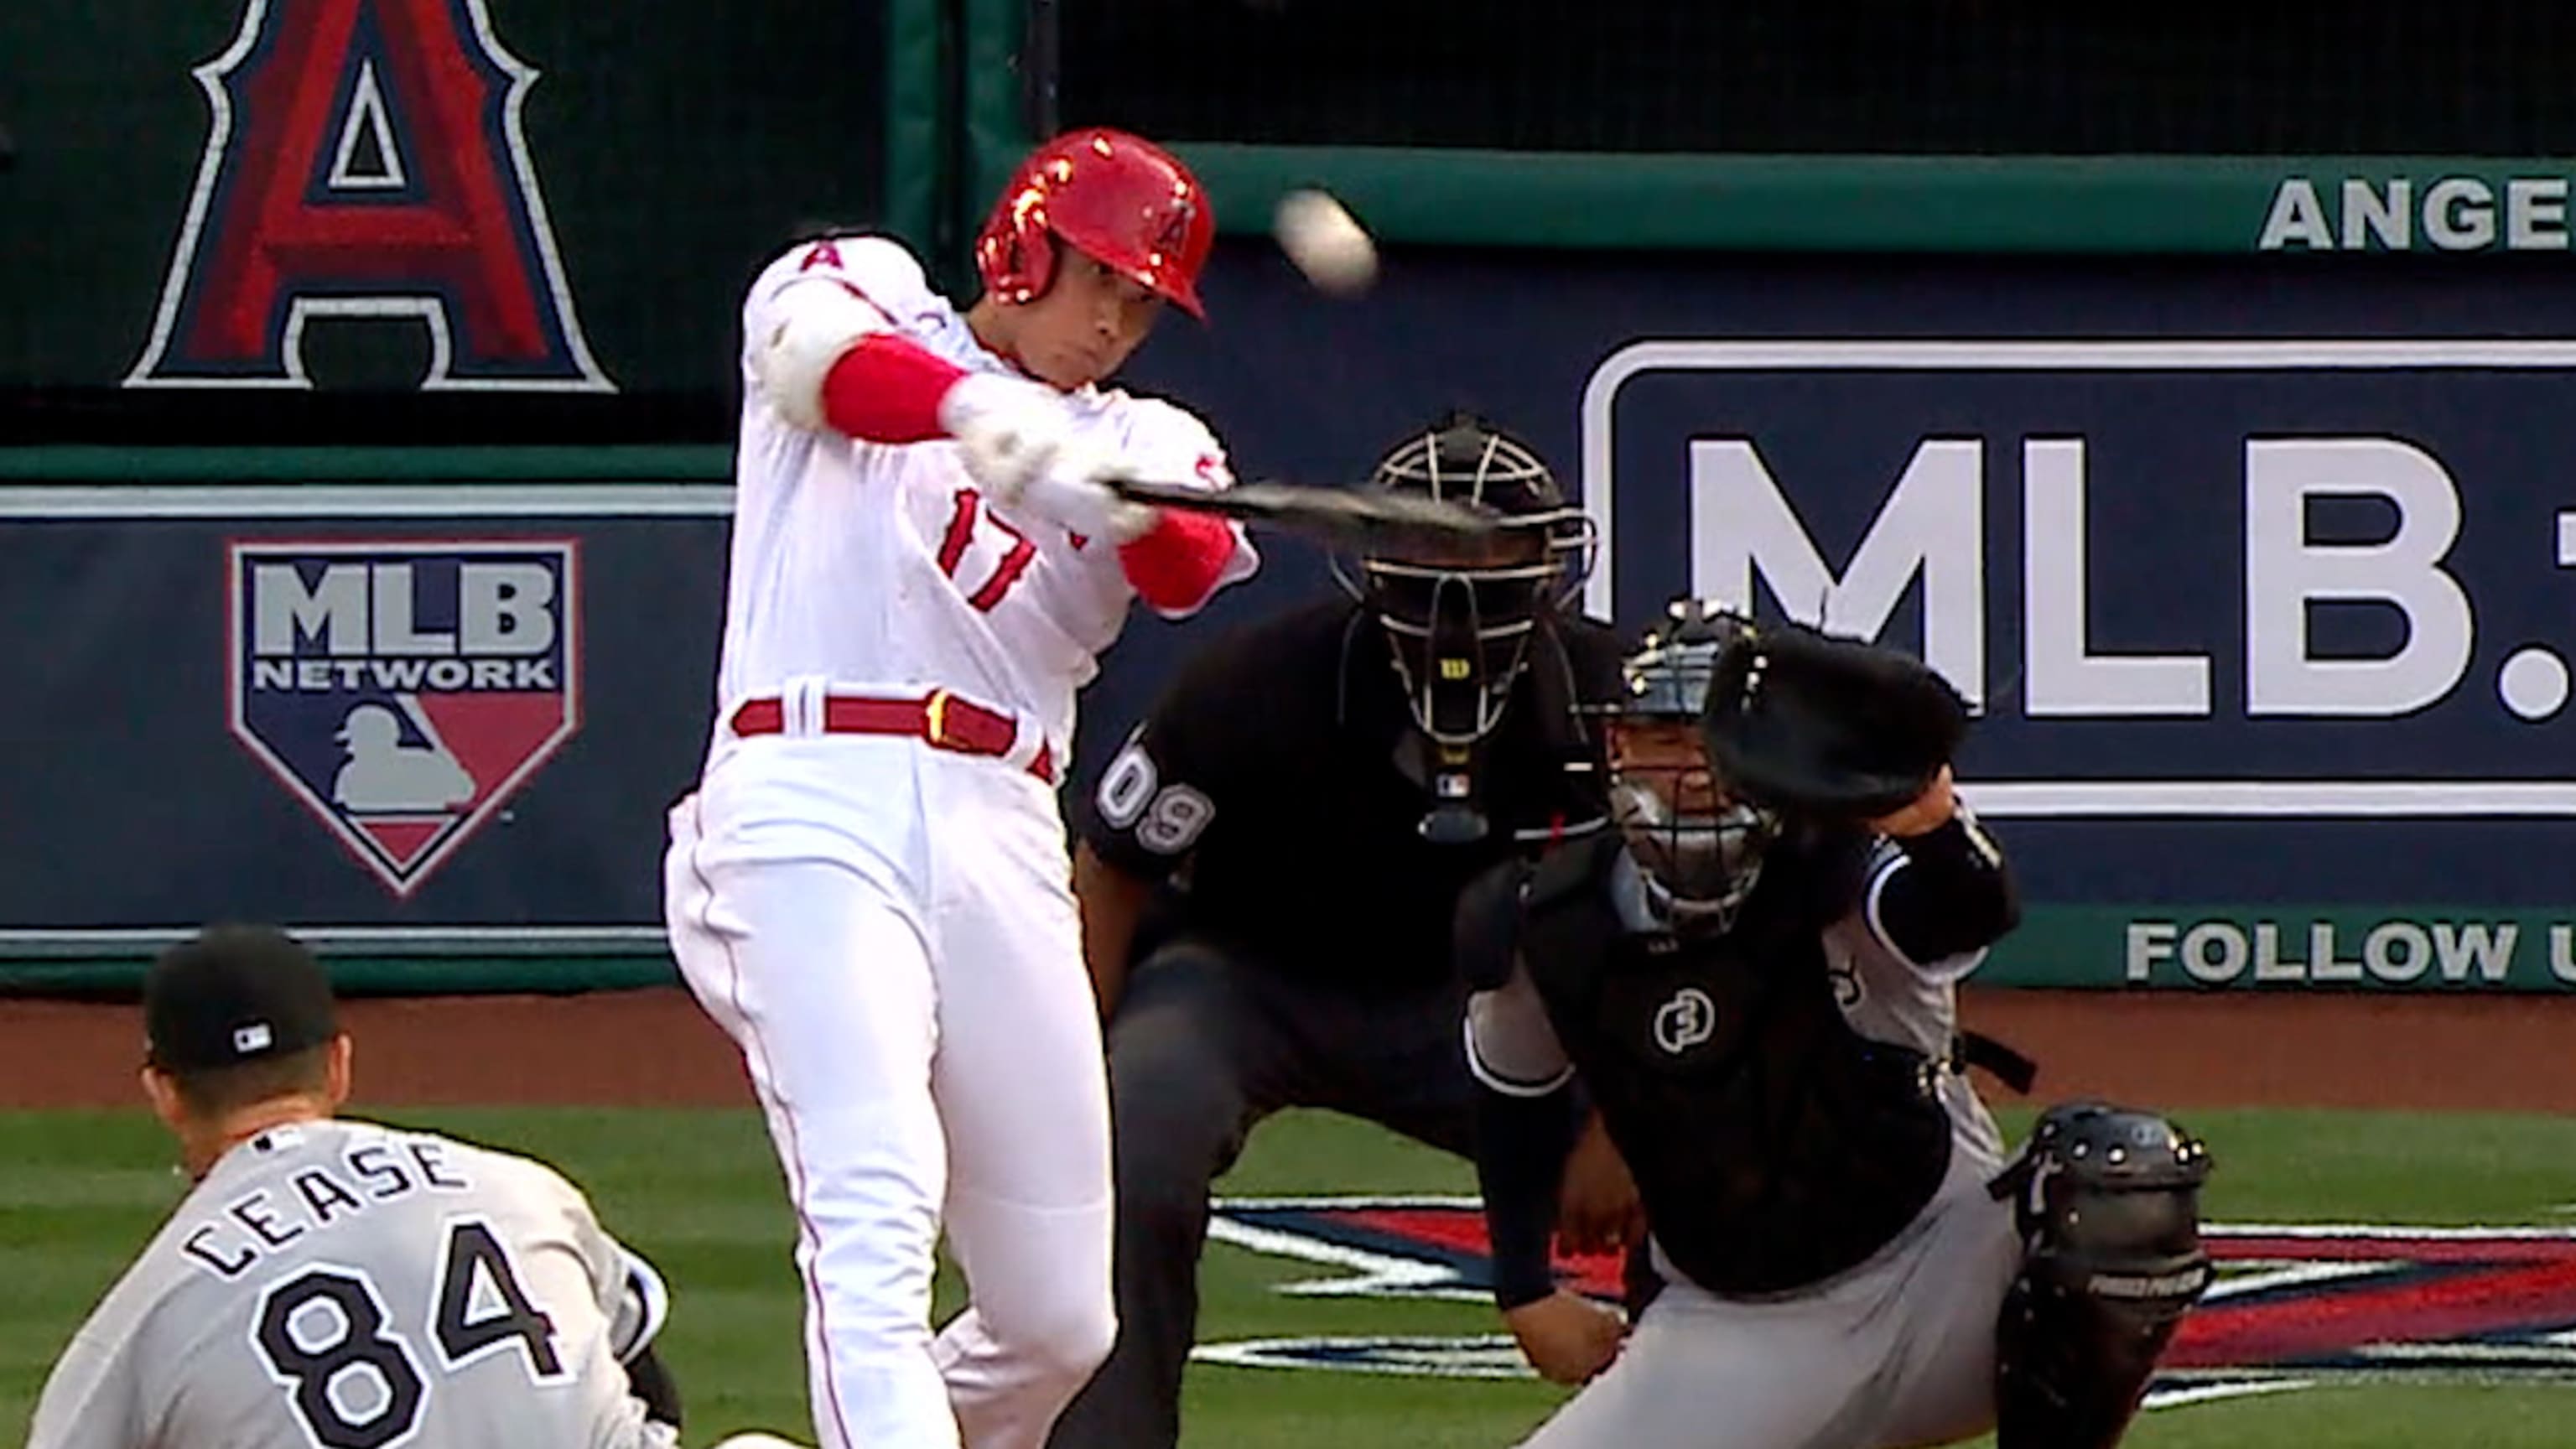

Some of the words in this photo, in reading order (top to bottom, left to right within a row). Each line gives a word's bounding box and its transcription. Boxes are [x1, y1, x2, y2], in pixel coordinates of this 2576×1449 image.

[122, 0, 619, 392] A
[2259, 179, 2569, 250] ANGE
[937, 487, 1037, 613] 17
[1690, 438, 2576, 719] MLB.
[254, 564, 555, 656] MLB
[254, 660, 555, 689] NETWORK
[1094, 742, 1217, 855] 09
[2126, 923, 2520, 981] FOLLOW
[182, 1140, 470, 1276] CEASE
[253, 1215, 574, 1448] 84
